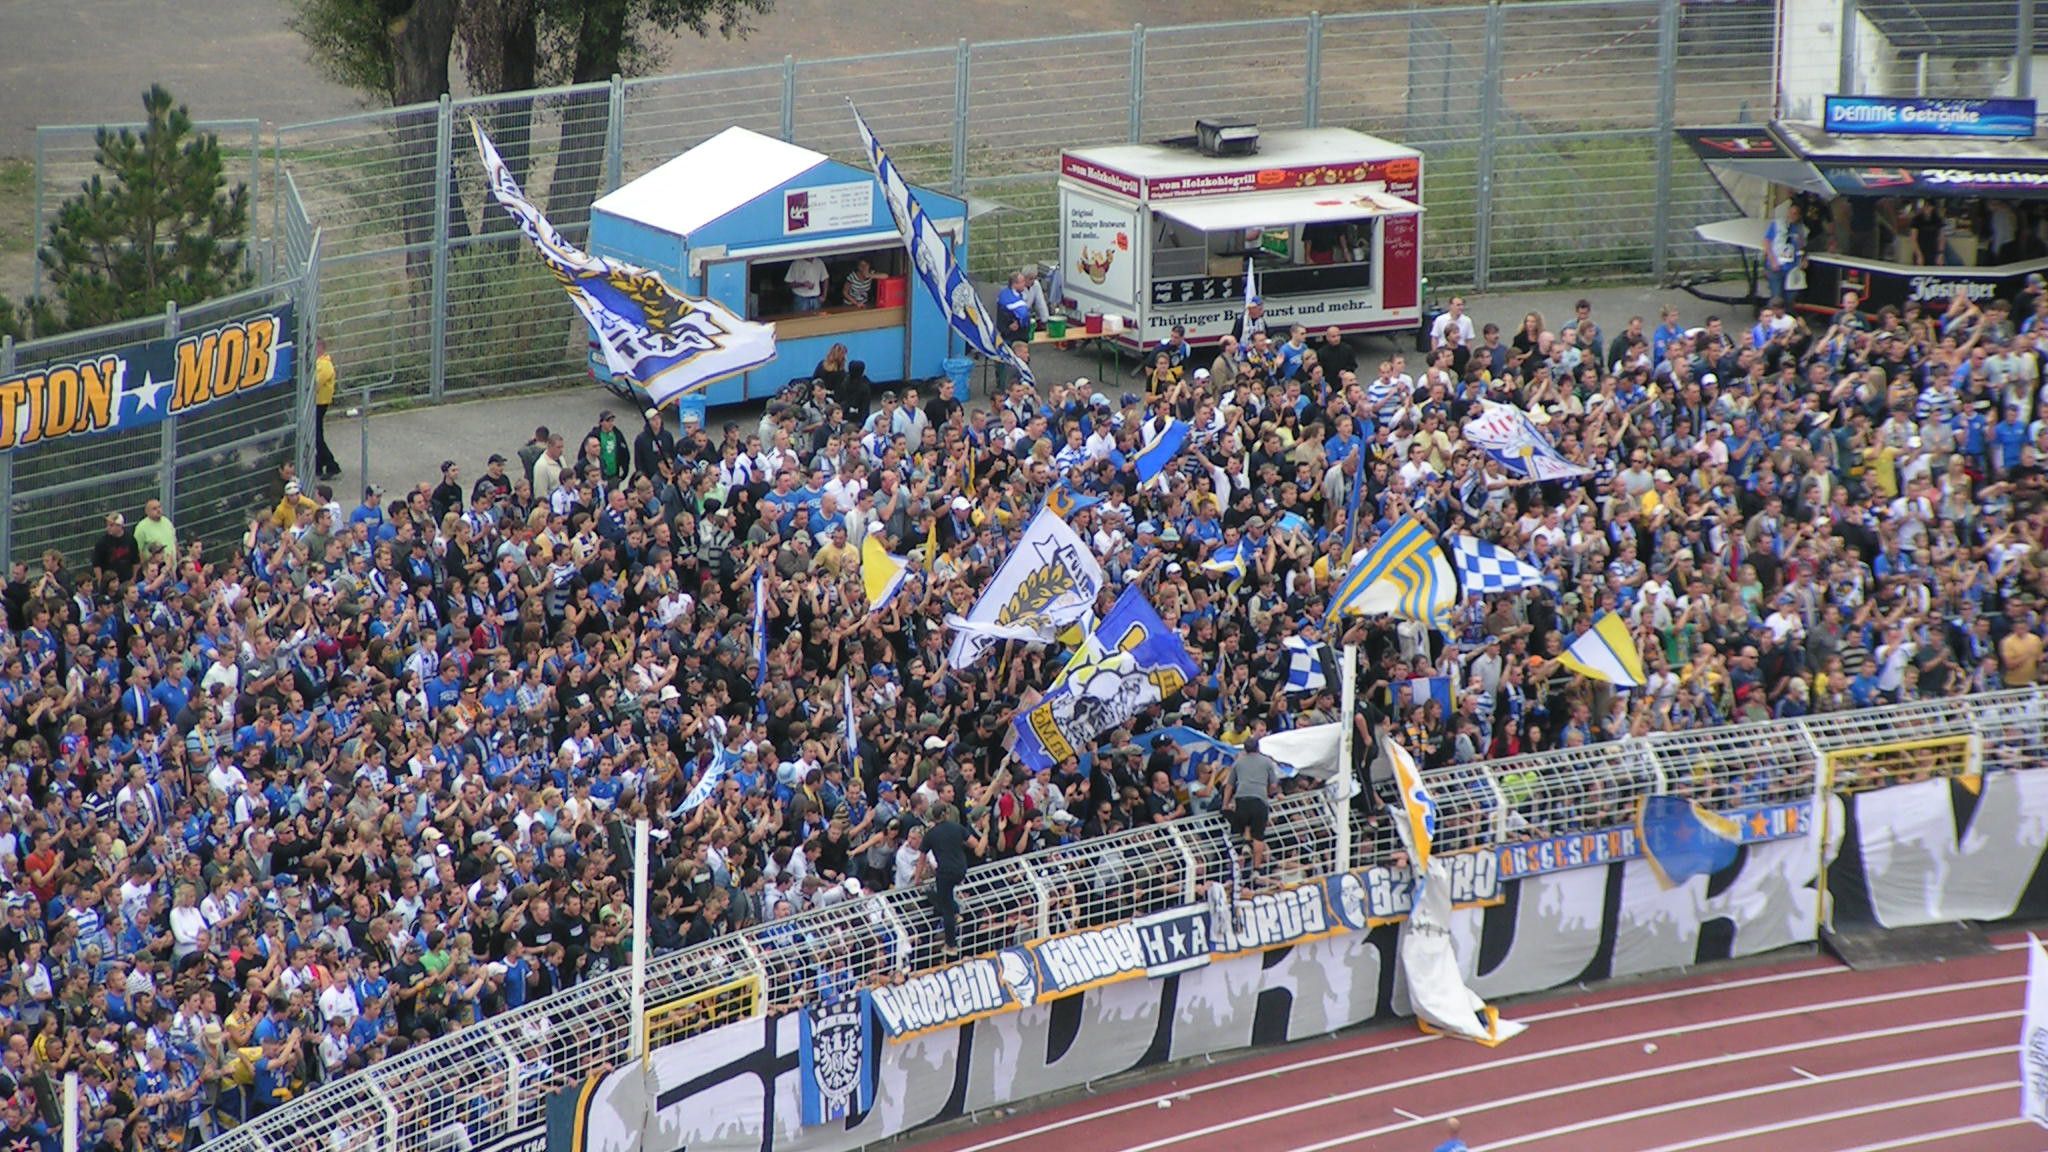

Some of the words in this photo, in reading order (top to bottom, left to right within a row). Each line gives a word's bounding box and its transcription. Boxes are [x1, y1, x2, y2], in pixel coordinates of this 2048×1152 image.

[1833, 105, 1897, 122] DEMME
[1900, 105, 1980, 123] Getränke
[1182, 174, 1256, 189] Holzkohlegrill
[1148, 309, 1220, 329] Thüringer
[1223, 303, 1295, 323] Brwurst
[1298, 302, 1325, 315] und
[169, 316, 275, 413] MOB
